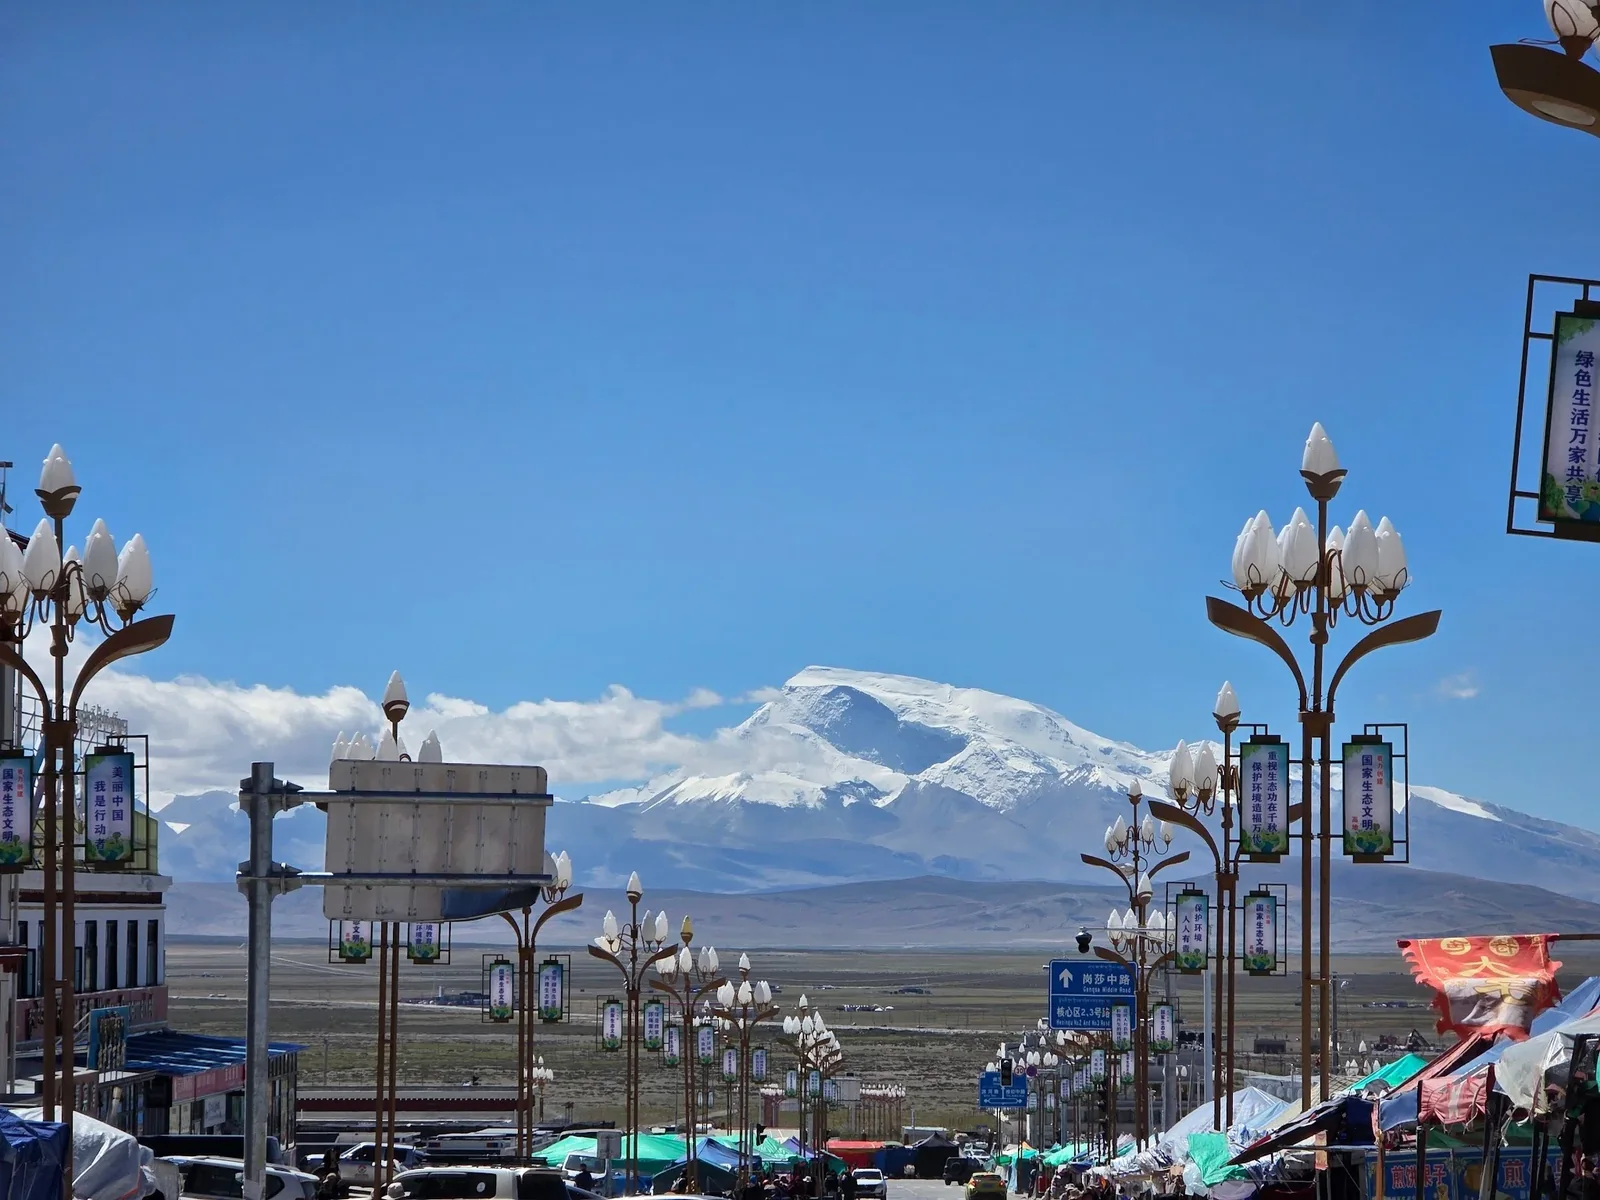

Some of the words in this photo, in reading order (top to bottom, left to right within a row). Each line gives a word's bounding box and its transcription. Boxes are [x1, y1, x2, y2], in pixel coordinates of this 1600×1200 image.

[1565, 350, 1595, 502] 绿色生活万家共享
[2, 768, 13, 842] 国家生态文明
[94, 780, 106, 850] 我是行动者
[112, 766, 123, 822] 美丽中国
[1251, 761, 1262, 844] 保护环境造福万代
[1267, 751, 1278, 832] 重视生态功在千秋
[1351, 815, 1359, 831] 高地
[1361, 754, 1373, 831] 国家生态文明
[1194, 903, 1203, 943] 保护环境
[1255, 903, 1264, 955] 国家生态文明
